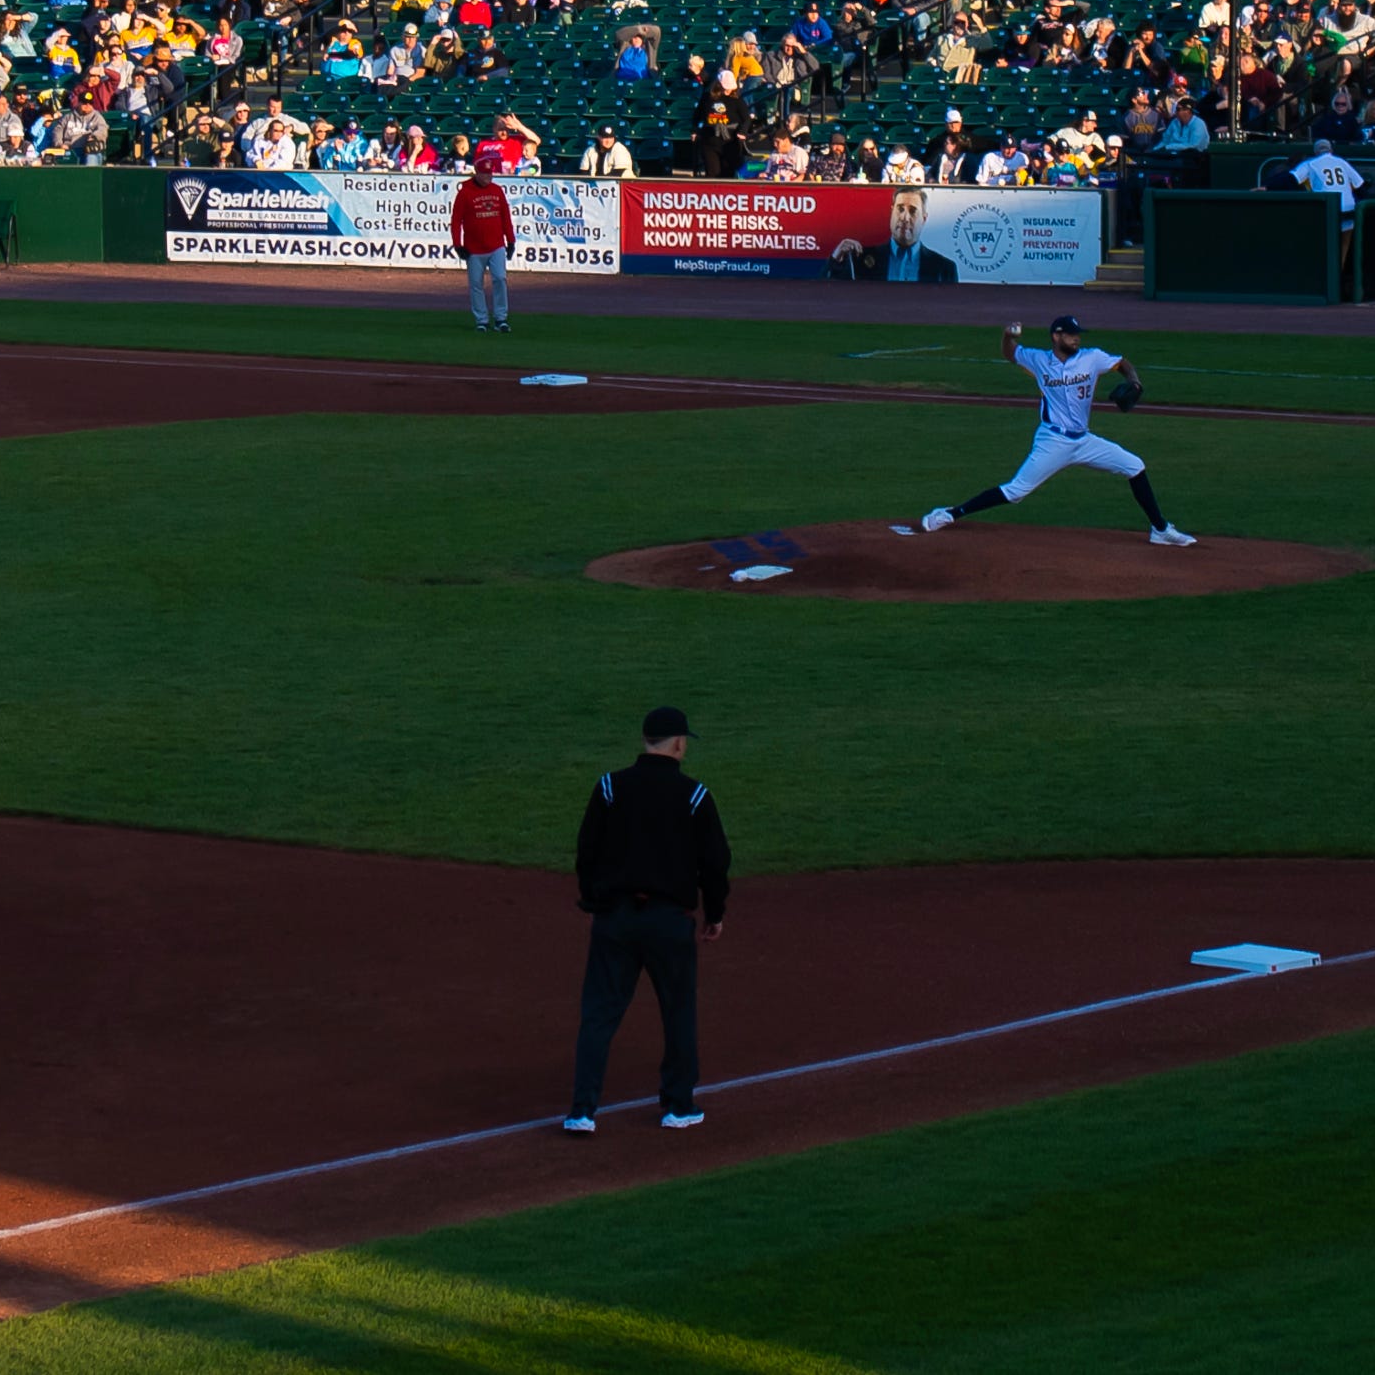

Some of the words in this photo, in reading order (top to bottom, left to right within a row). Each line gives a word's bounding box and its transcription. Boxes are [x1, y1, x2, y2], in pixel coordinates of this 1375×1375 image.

[1323, 167, 1345, 187] 36
[207, 187, 330, 209] SparkleWash
[343, 179, 436, 193] Residential
[575, 185, 617, 199] Fleet
[376, 200, 413, 217] High
[554, 206, 584, 219] and
[643, 193, 749, 212] INSURANCE
[753, 195, 816, 214] FRAUD
[217, 211, 244, 219] YORK
[258, 213, 316, 221] LANCASTER
[643, 213, 694, 228] KNOW
[697, 213, 728, 230] THE
[731, 215, 784, 231] RISKS.
[952, 203, 1010, 239] COMMONWEALTH
[1008, 227, 1015, 240] OF
[1023, 218, 1076, 227] INSURANCE
[207, 221, 257, 229] PROFESSIONAL
[297, 223, 328, 231] WASHING
[353, 217, 452, 233] Cost-Effectiv
[535, 223, 606, 241] Washing.
[1023, 229, 1053, 237] FRAUD
[643, 231, 694, 247] KNOW
[697, 233, 728, 248] THE
[732, 234, 821, 251] PENALTIES.
[972, 232, 995, 243] IFPA
[1023, 241, 1080, 249] PREVENTION
[173, 237, 456, 260] SPARKLEWASH.COM/YORK
[1023, 253, 1075, 261] AUTHORITY
[675, 259, 770, 274] HelpStopFraud.org
[955, 249, 1012, 273] PENNSYLVANIA
